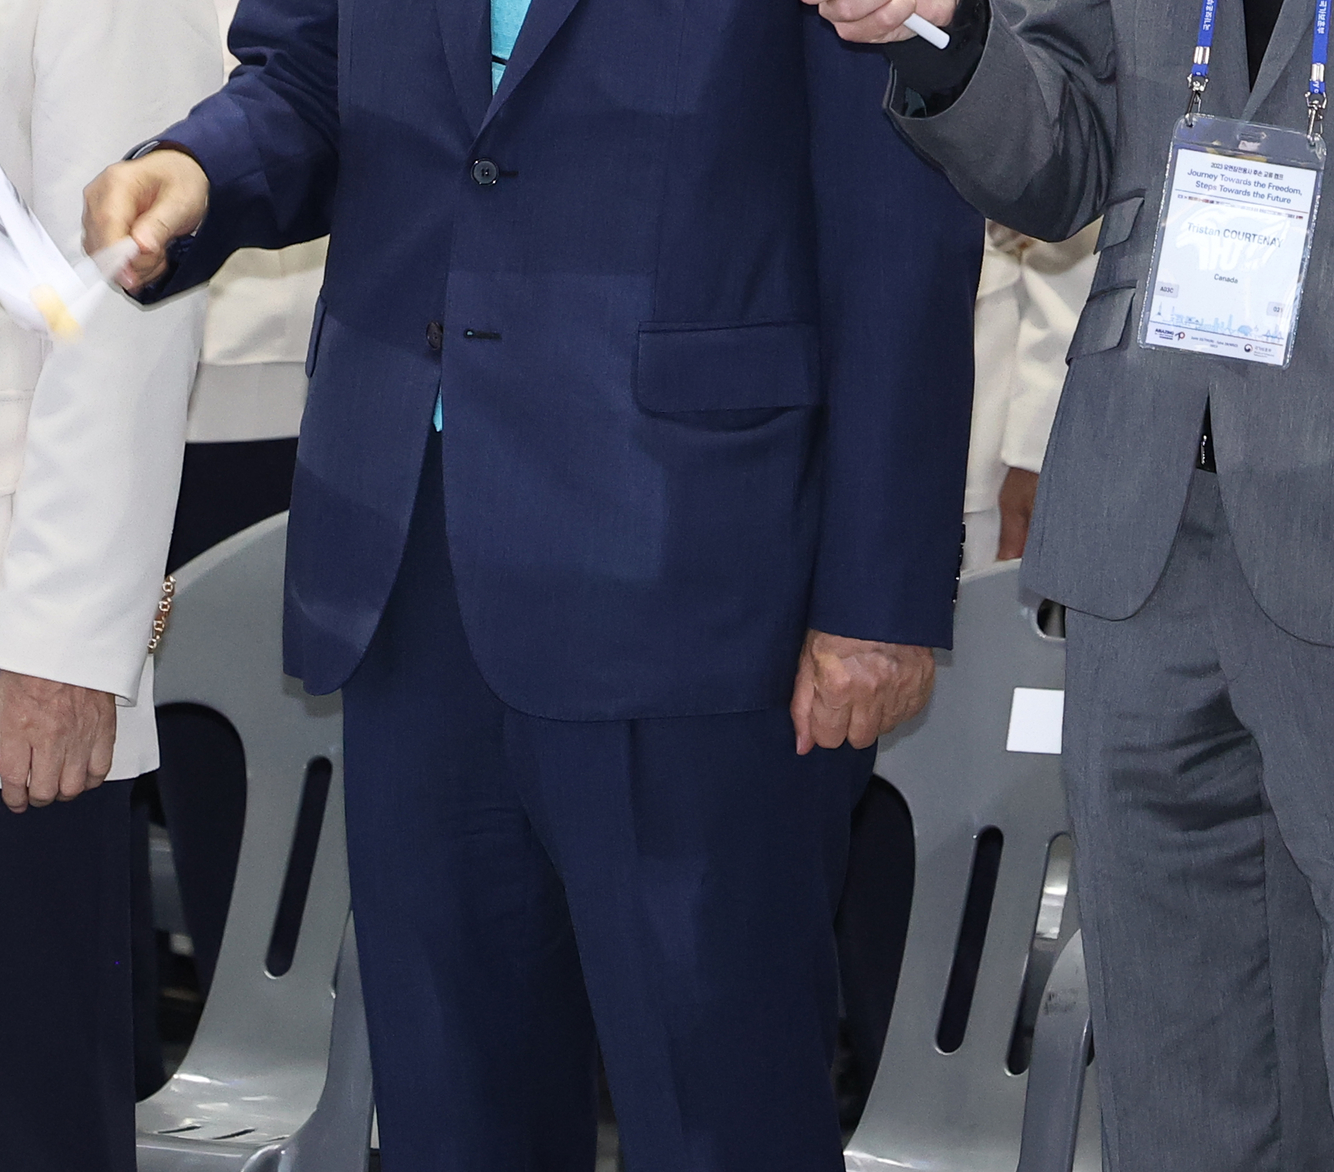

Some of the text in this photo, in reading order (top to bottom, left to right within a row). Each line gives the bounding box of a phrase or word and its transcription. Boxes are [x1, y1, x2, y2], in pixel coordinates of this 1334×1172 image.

[1187, 168, 1303, 196] Journey Towards the Freedom,
[1195, 180, 1292, 204] Steps Towards the Future
[1187, 222, 1284, 248] Tristan COURTENAY
[1214, 273, 1239, 284] Canada
